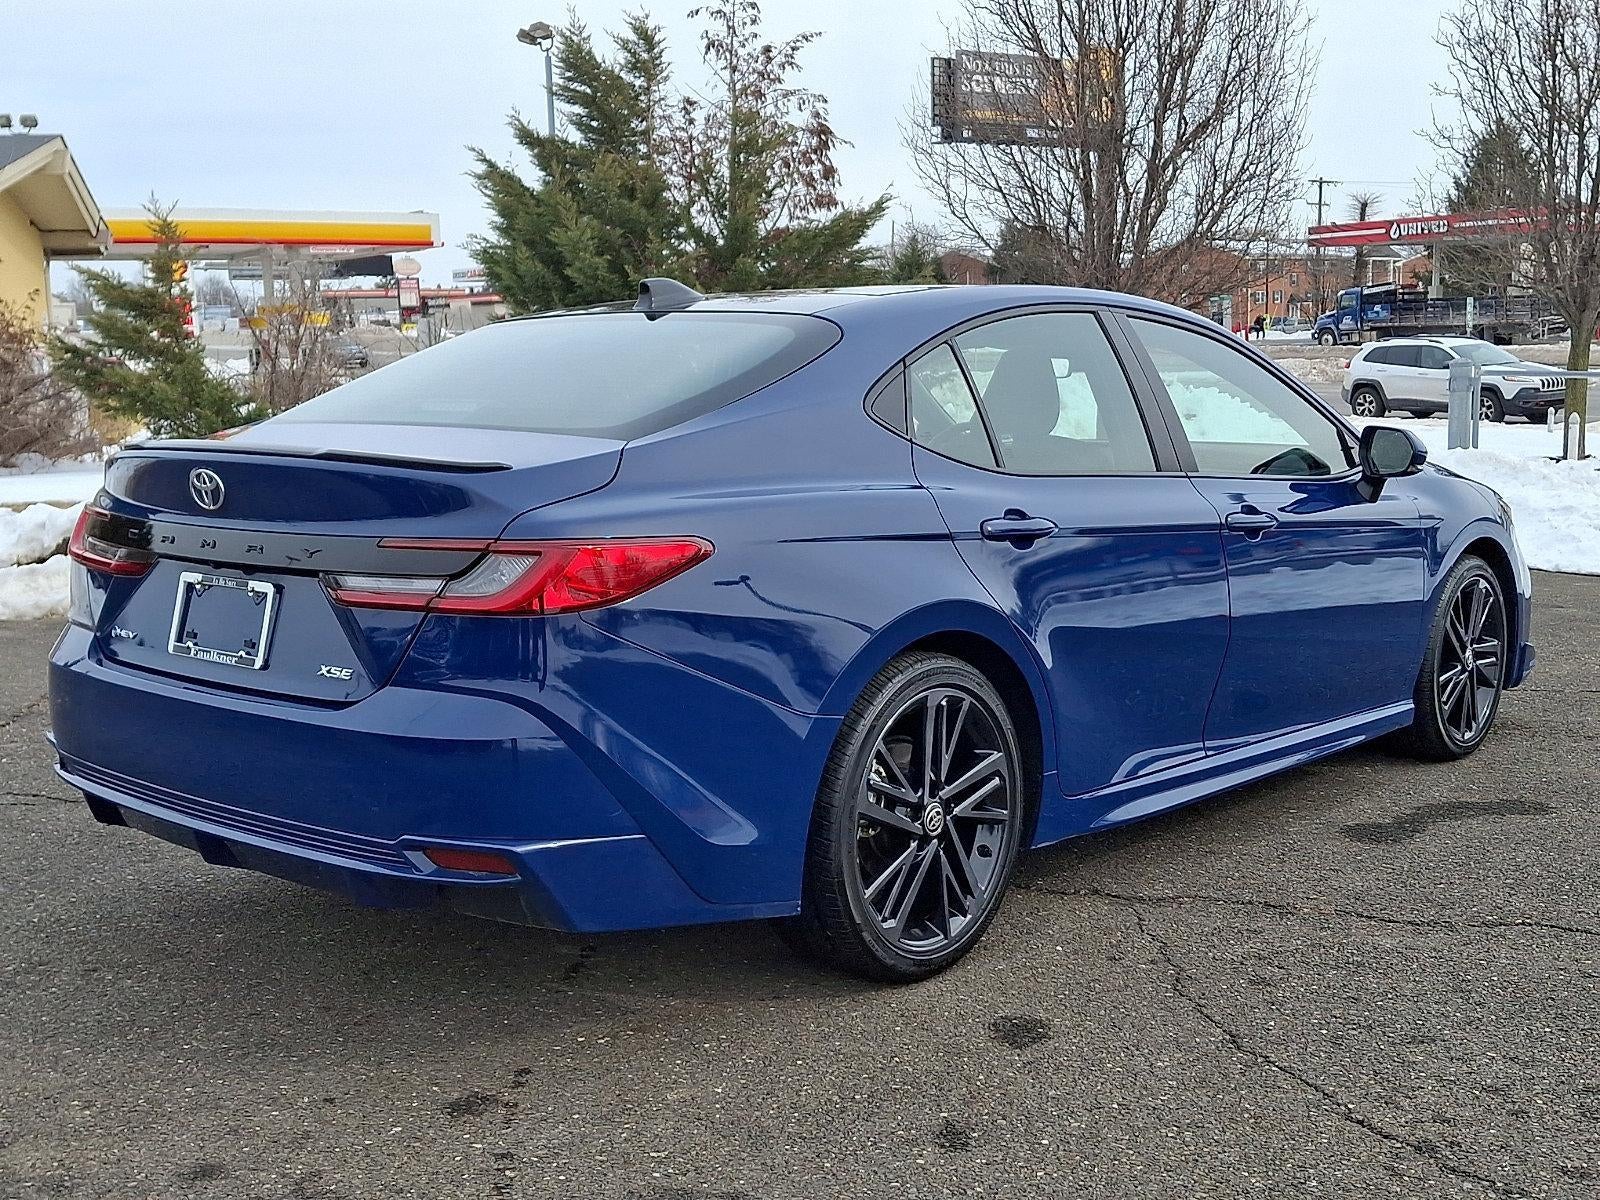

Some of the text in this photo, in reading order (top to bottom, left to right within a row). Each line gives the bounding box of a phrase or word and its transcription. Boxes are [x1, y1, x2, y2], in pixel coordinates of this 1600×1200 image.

[1400, 219, 1447, 236] UNITED
[190, 647, 239, 665] Faulkner
[316, 664, 354, 680] XSE
